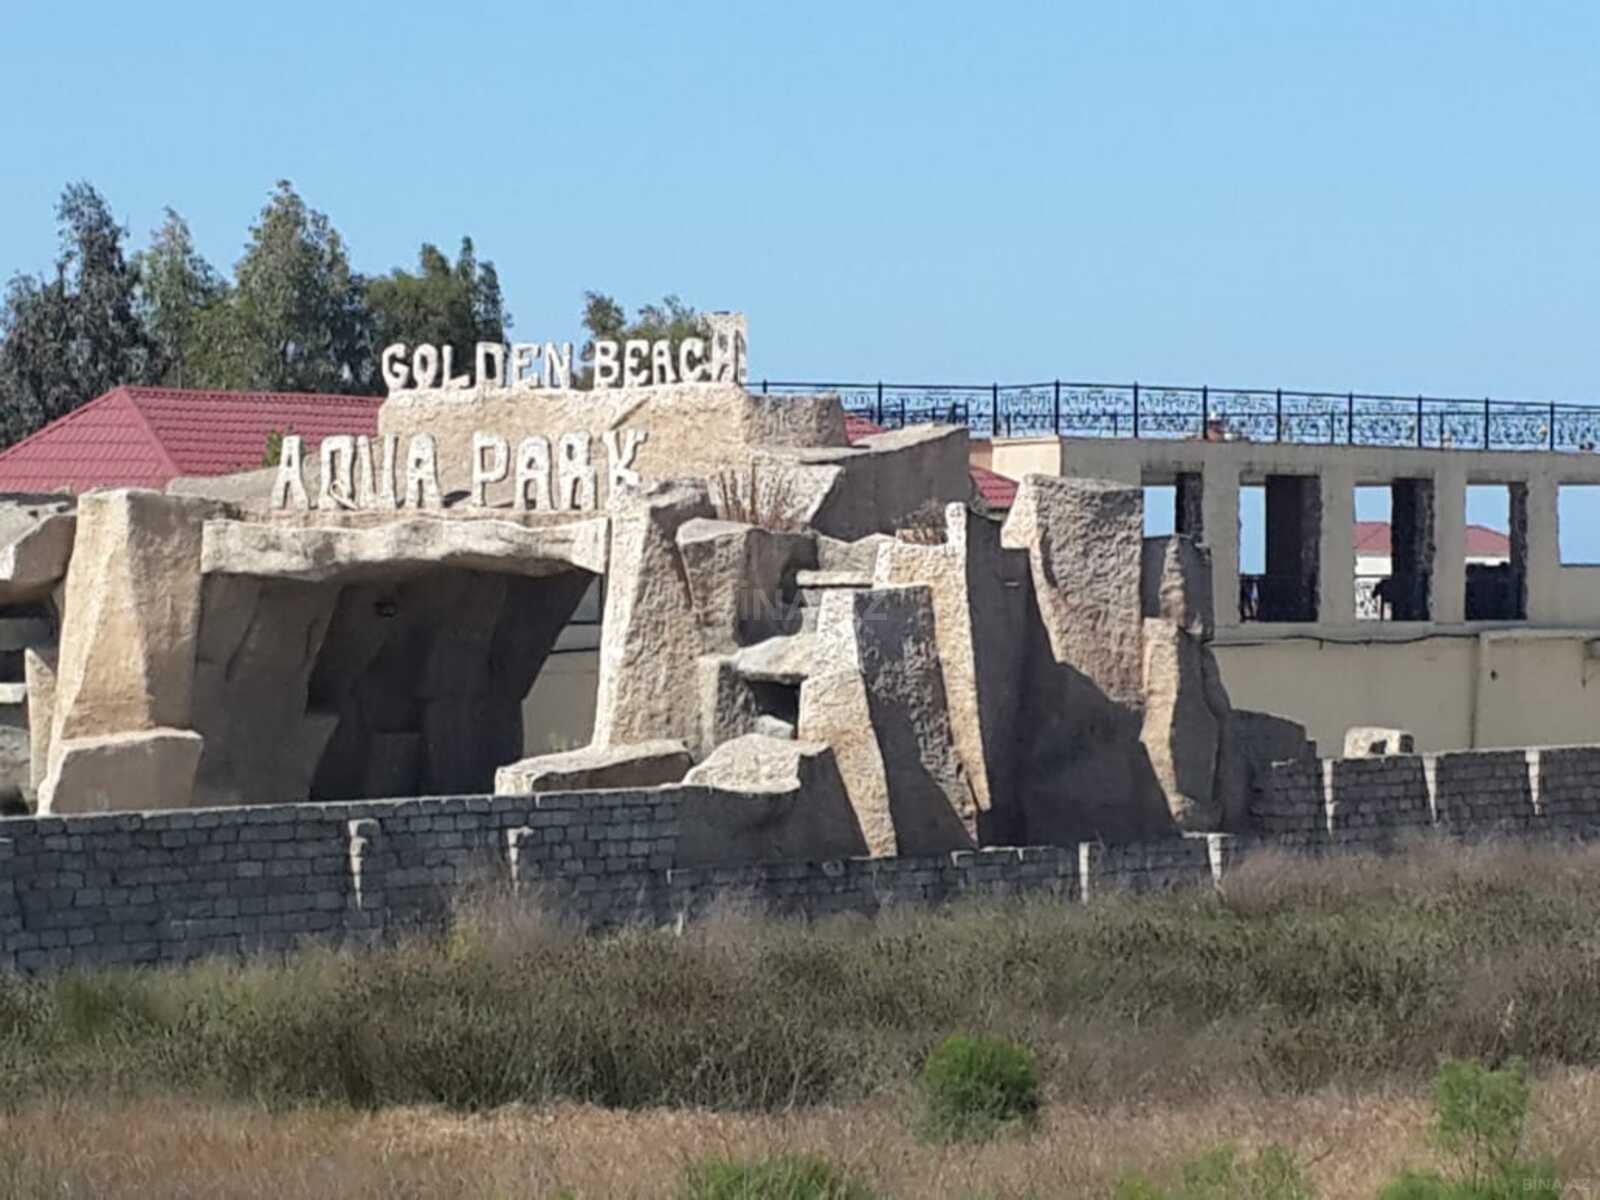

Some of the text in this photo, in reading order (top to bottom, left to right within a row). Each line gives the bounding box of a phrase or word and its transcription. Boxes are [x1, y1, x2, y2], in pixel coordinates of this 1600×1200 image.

[381, 332, 743, 389] GOLDEN BEACH
[270, 430, 650, 512] AQUA PARK
